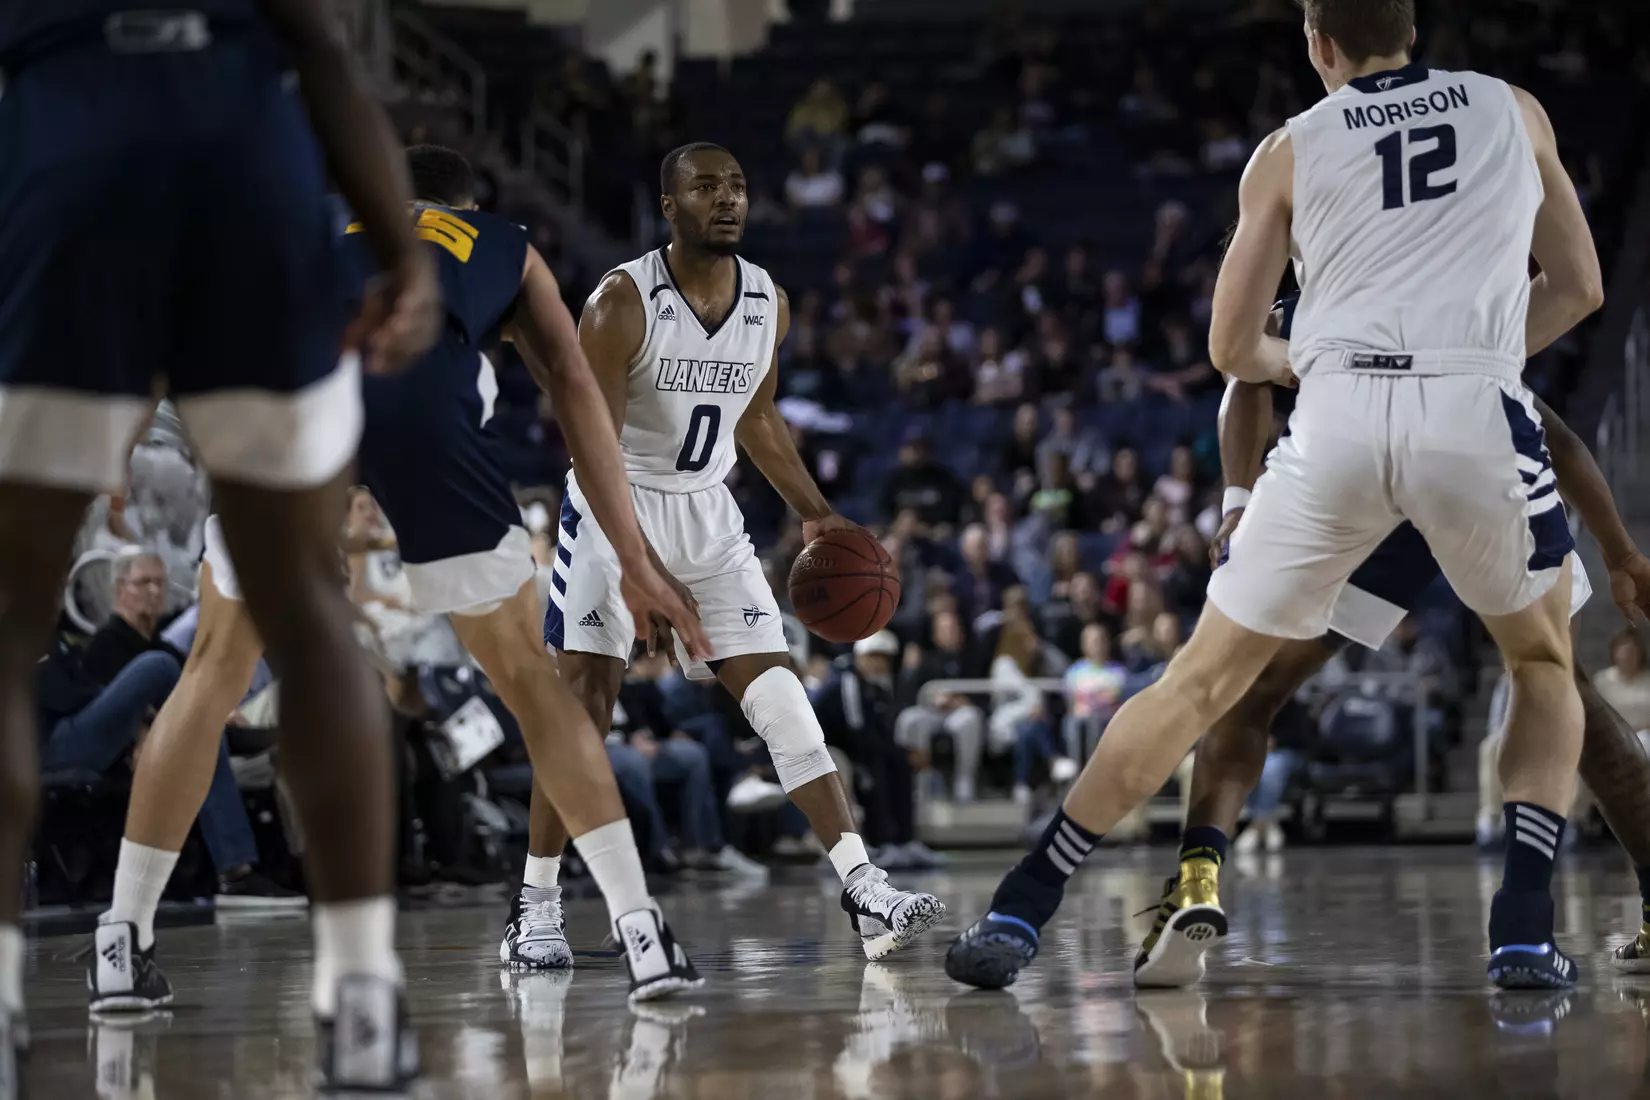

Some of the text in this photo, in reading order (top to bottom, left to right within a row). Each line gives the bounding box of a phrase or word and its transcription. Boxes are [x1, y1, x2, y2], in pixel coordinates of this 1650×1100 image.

[1343, 84, 1470, 129] MORISON
[1374, 123, 1458, 210] 12
[744, 315, 764, 326] WAC
[656, 358, 754, 393] LANCERS
[675, 404, 721, 472] 0
